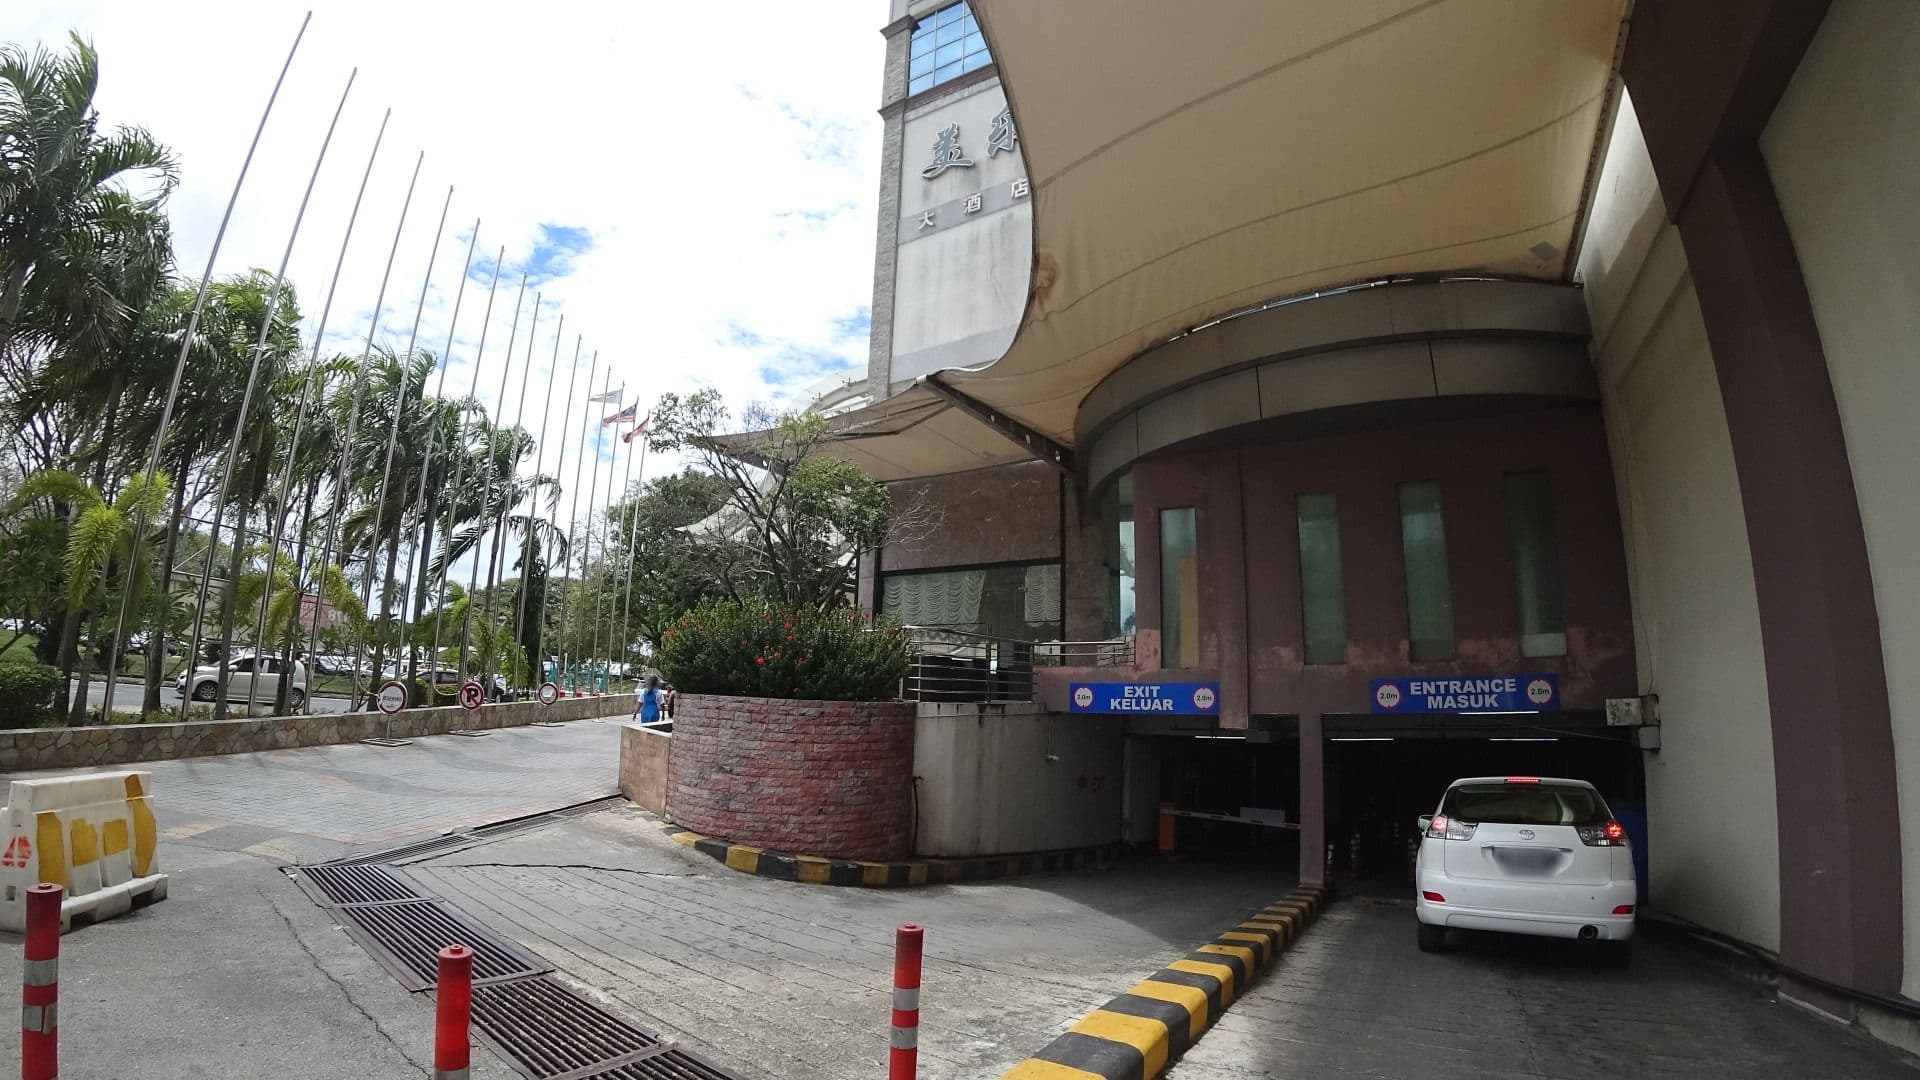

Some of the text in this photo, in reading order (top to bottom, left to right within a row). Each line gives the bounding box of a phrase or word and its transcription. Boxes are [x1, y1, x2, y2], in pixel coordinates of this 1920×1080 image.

[918, 178, 1029, 230] 大酒店
[1123, 685, 1161, 698] EXIT
[1409, 678, 1517, 696] ENTRANCE
[1530, 687, 1551, 696] 2.0m
[1379, 692, 1399, 700] 2.0m
[1426, 693, 1500, 709] MASUK
[1109, 698, 1175, 711] KELUAR
